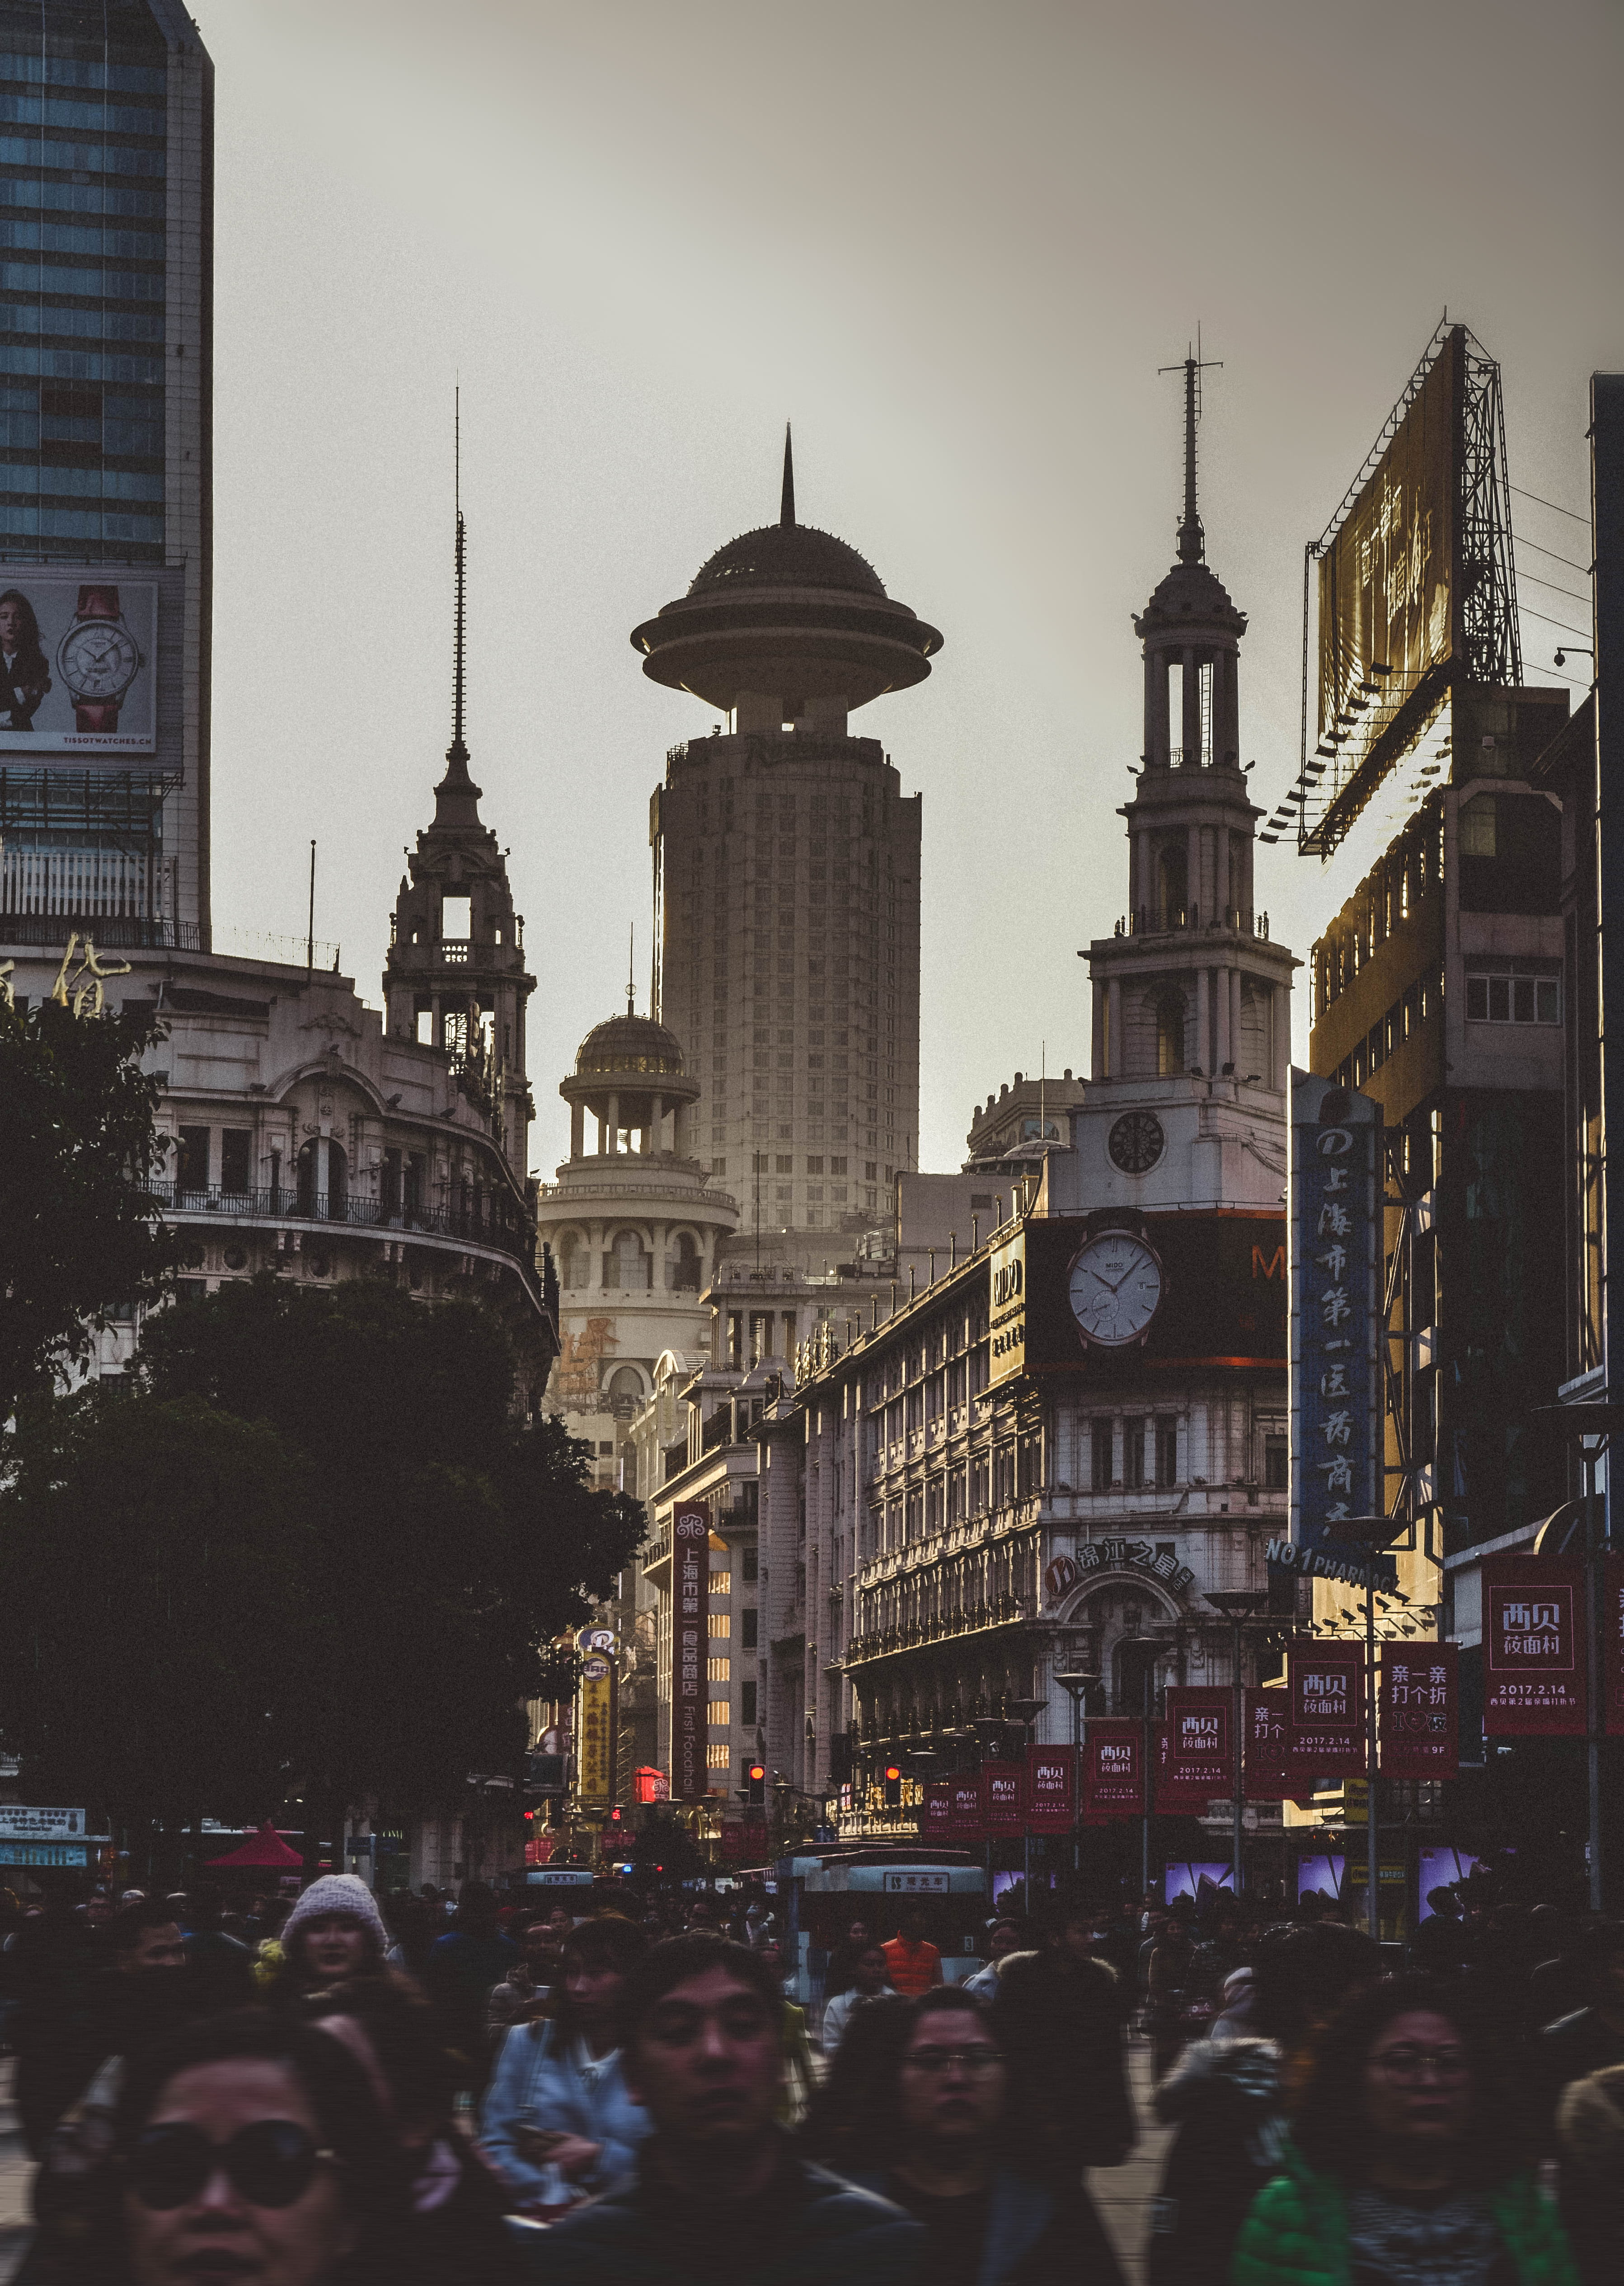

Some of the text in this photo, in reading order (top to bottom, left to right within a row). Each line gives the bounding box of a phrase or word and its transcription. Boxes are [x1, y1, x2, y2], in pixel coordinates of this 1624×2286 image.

[994, 1259, 1023, 1307] MIDO
[1077, 1538, 1178, 1580] 锦江之星
[1266, 1538, 1313, 1571] NO.1
[682, 1548, 699, 1696] 上海市第一食品商店
[1503, 1604, 1559, 1631] 西贝
[1392, 1665, 1446, 1684] 亲一亲
[1304, 1675, 1346, 1696] 西贝
[1499, 1685, 1566, 1695] 2017.2.14
[1392, 1686, 1446, 1705] 打个折
[1182, 1717, 1218, 1735] 西贝
[683, 1706, 695, 1793] First Foodhall
[1300, 1737, 1350, 1745] 2017.2.14
[1101, 1746, 1131, 1760] 西贝
[1037, 1766, 1063, 1779] 西贝
[992, 1780, 1015, 1792] 西贝
